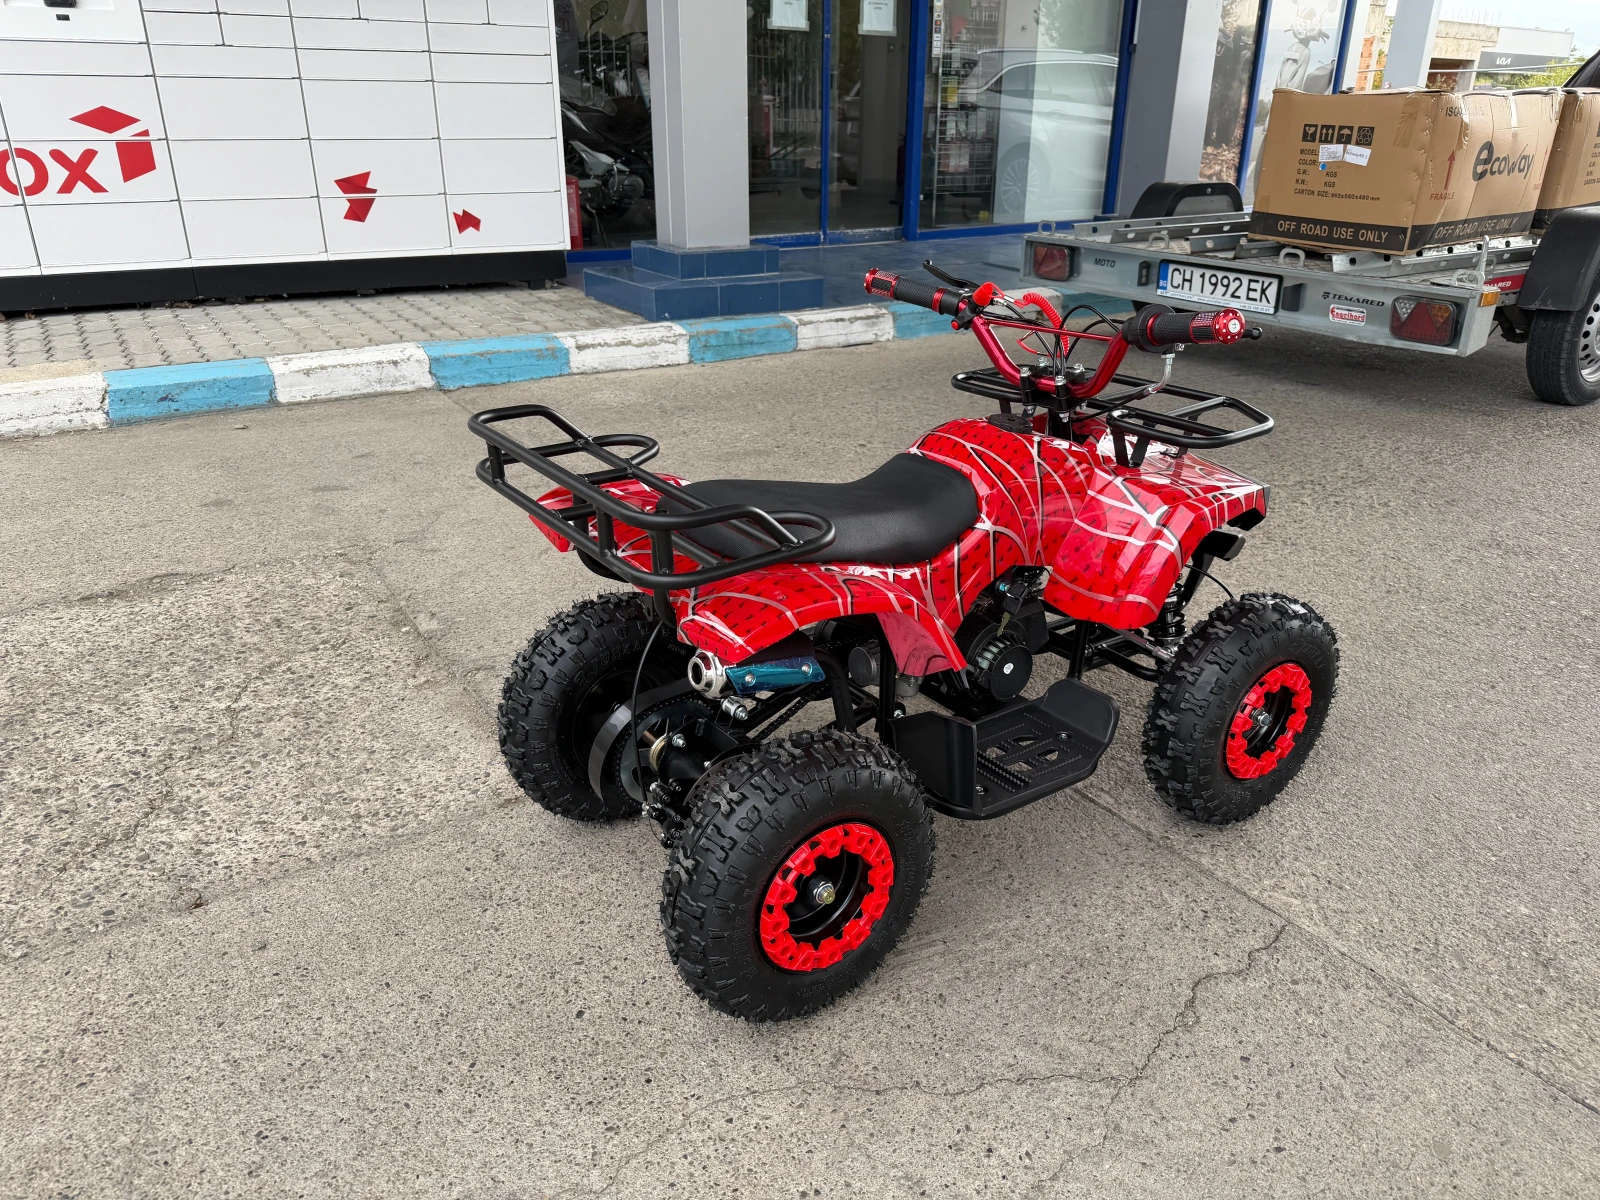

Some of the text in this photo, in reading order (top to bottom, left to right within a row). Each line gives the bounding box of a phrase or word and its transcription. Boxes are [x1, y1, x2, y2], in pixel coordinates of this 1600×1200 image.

[1298, 158, 1318, 166] COLOR:
[1293, 187, 1315, 197] CARTON
[1429, 191, 1456, 201] FRAGILE
[1277, 220, 1389, 243] OFF ROAD USE ONLY
[1434, 217, 1519, 239] OFF ROAD USE ONLY
[1093, 258, 1116, 268] MOTO
[1170, 267, 1274, 304] CH 1992 EK
[1331, 293, 1385, 307] TEMARED
